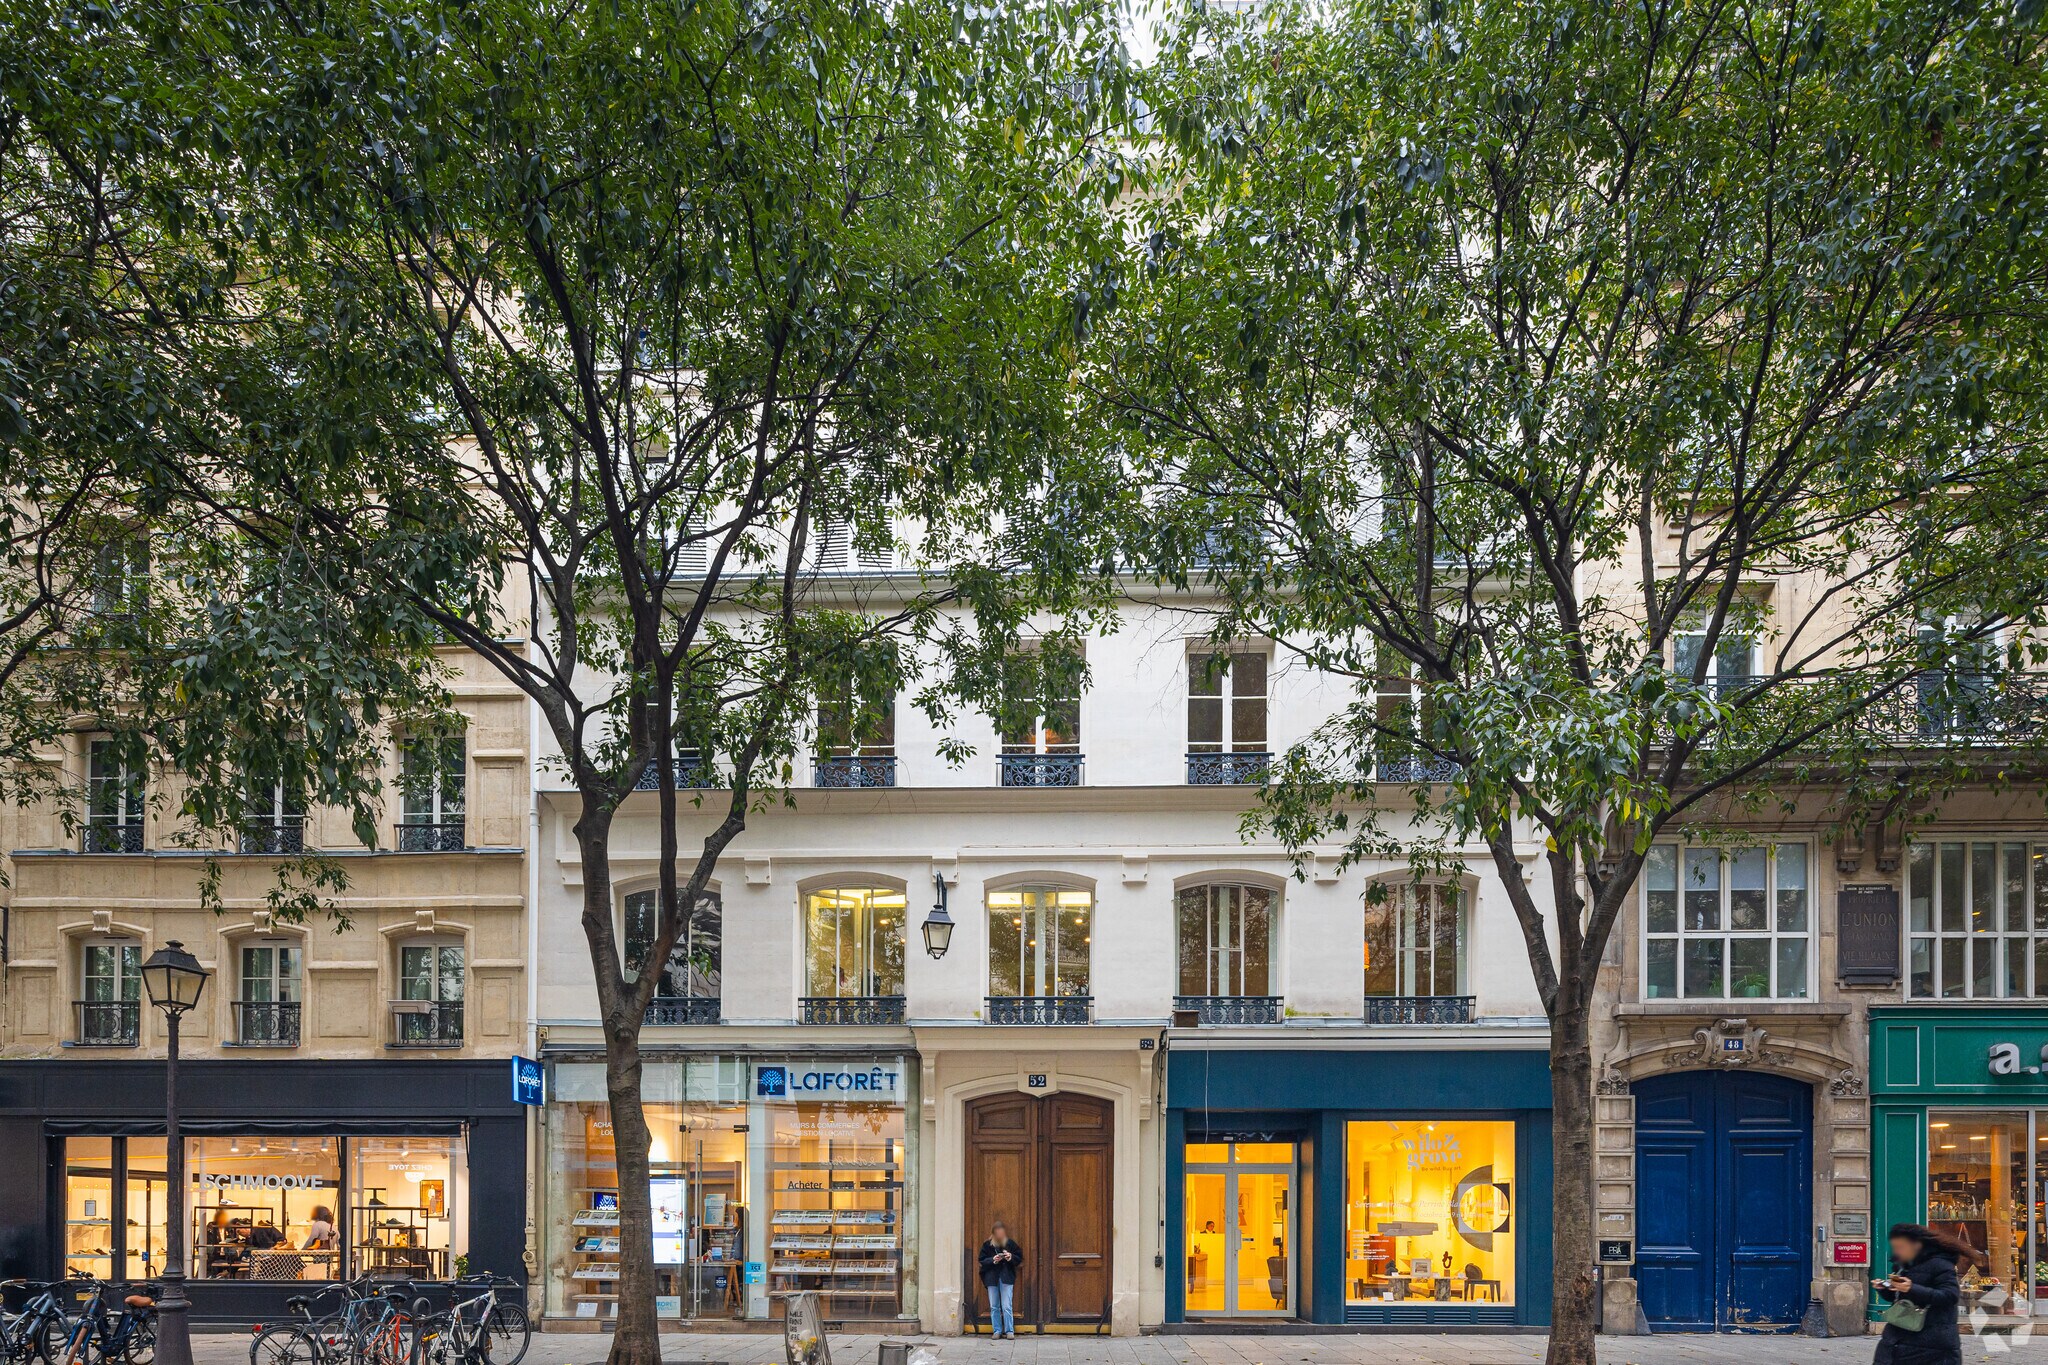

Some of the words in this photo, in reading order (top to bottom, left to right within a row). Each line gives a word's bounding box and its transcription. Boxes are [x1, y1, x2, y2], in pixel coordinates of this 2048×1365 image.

[1841, 912, 1897, 927] L'UNION
[1727, 1040, 1739, 1049] 48
[1030, 1075, 1045, 1086] 52
[200, 1174, 323, 1191] SCHMOOVE
[788, 1180, 822, 1190] Acheter
